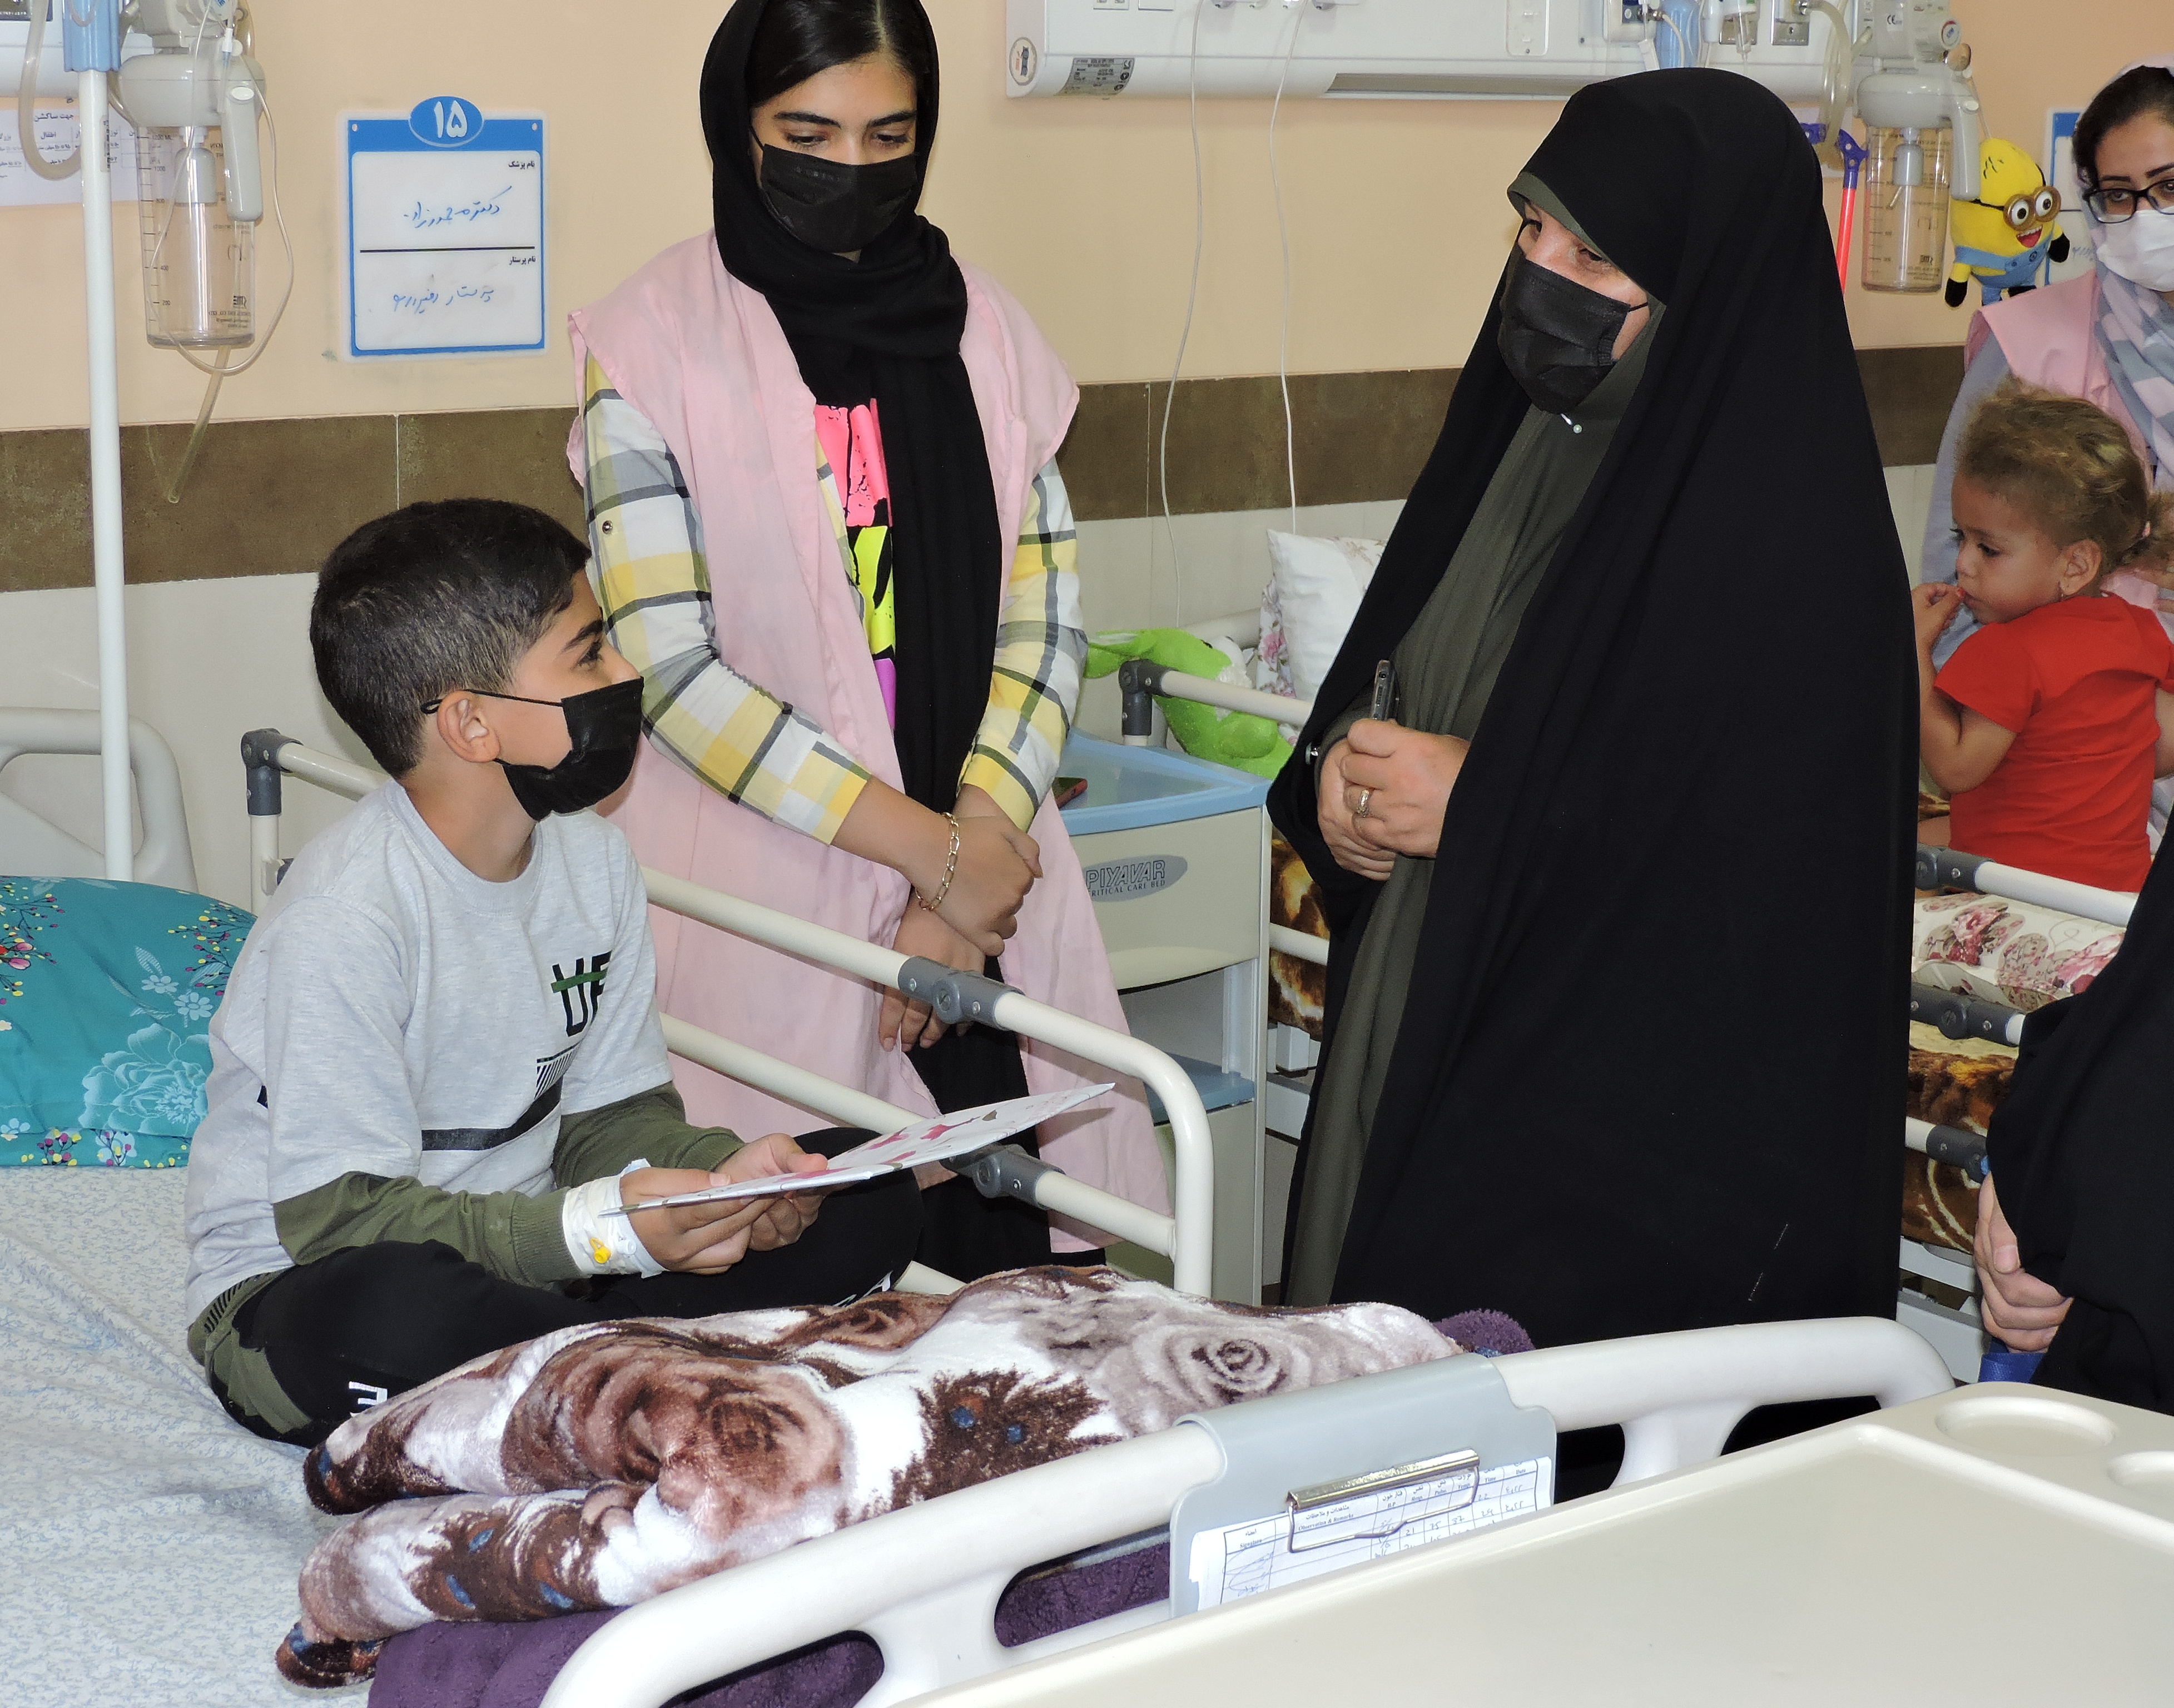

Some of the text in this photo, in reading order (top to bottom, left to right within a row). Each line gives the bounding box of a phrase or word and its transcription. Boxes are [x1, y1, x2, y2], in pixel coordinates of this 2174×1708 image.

[434, 100, 468, 138] ۱۵
[508, 161, 525, 170] پزشک
[509, 256, 536, 265] نام پرستار
[1086, 860, 1165, 890] PIYAVAR
[1128, 883, 1146, 892] CARE
[1151, 879, 1165, 888] BED
